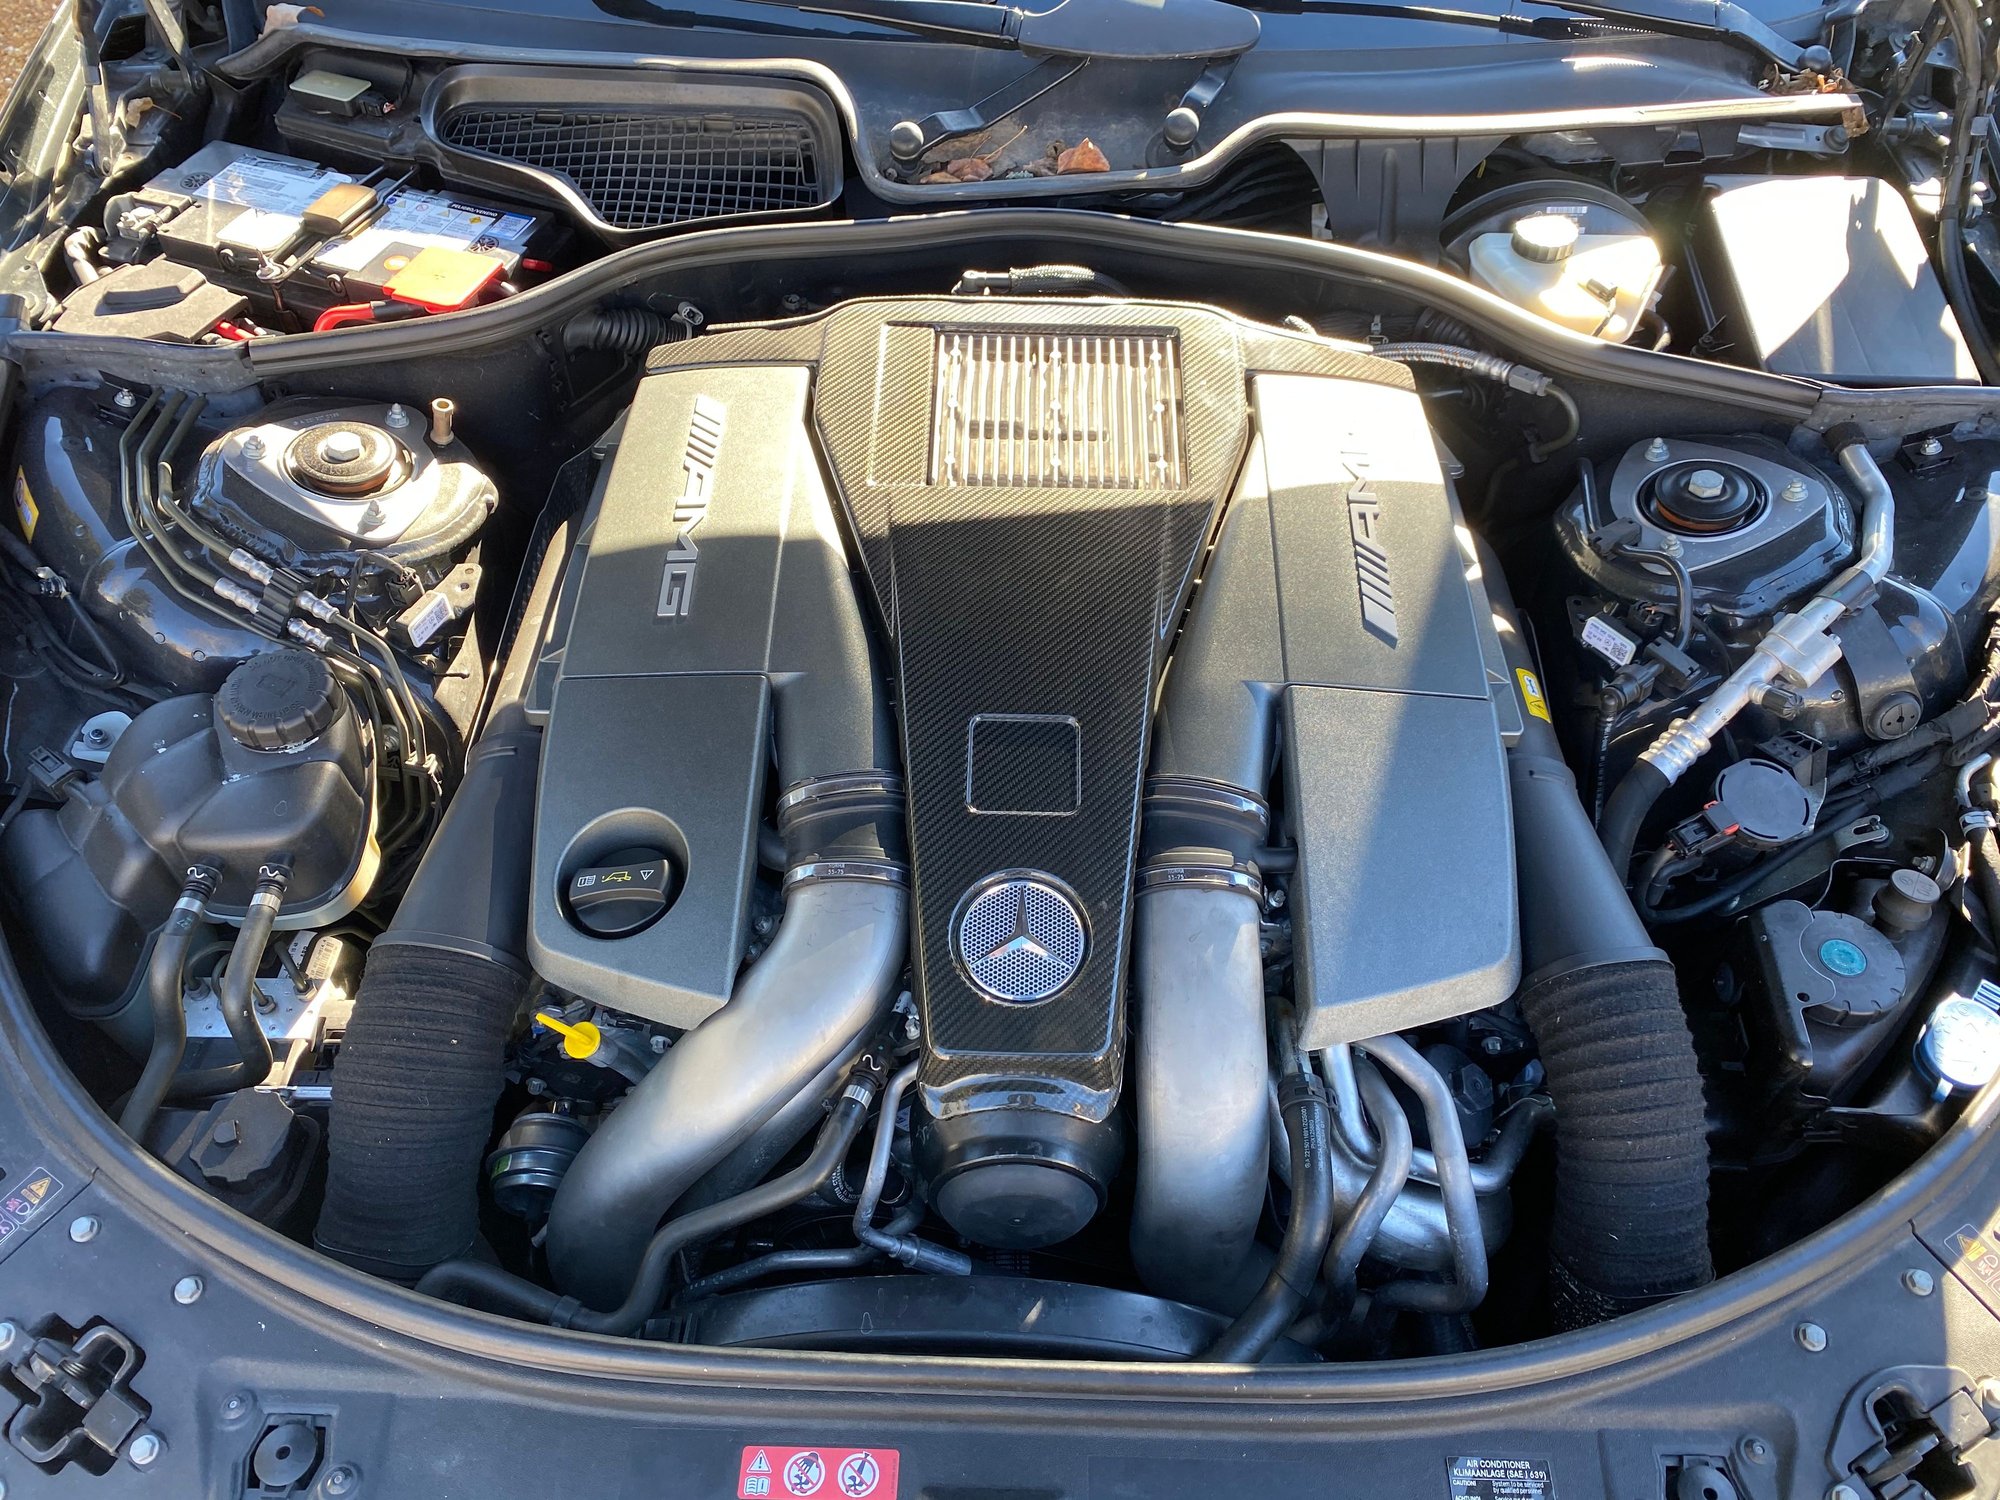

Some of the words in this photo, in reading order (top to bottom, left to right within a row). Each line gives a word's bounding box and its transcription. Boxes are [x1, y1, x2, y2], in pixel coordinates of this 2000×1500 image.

[656, 453, 716, 617] AMG
[1466, 1459, 1479, 1468] AIR
[1480, 1460, 1531, 1469] CONDITIONER
[1453, 1468, 1506, 1479] KLIMAANLAGE
[1506, 1470, 1523, 1479] (SAE
[1530, 1470, 1547, 1481] 639)
